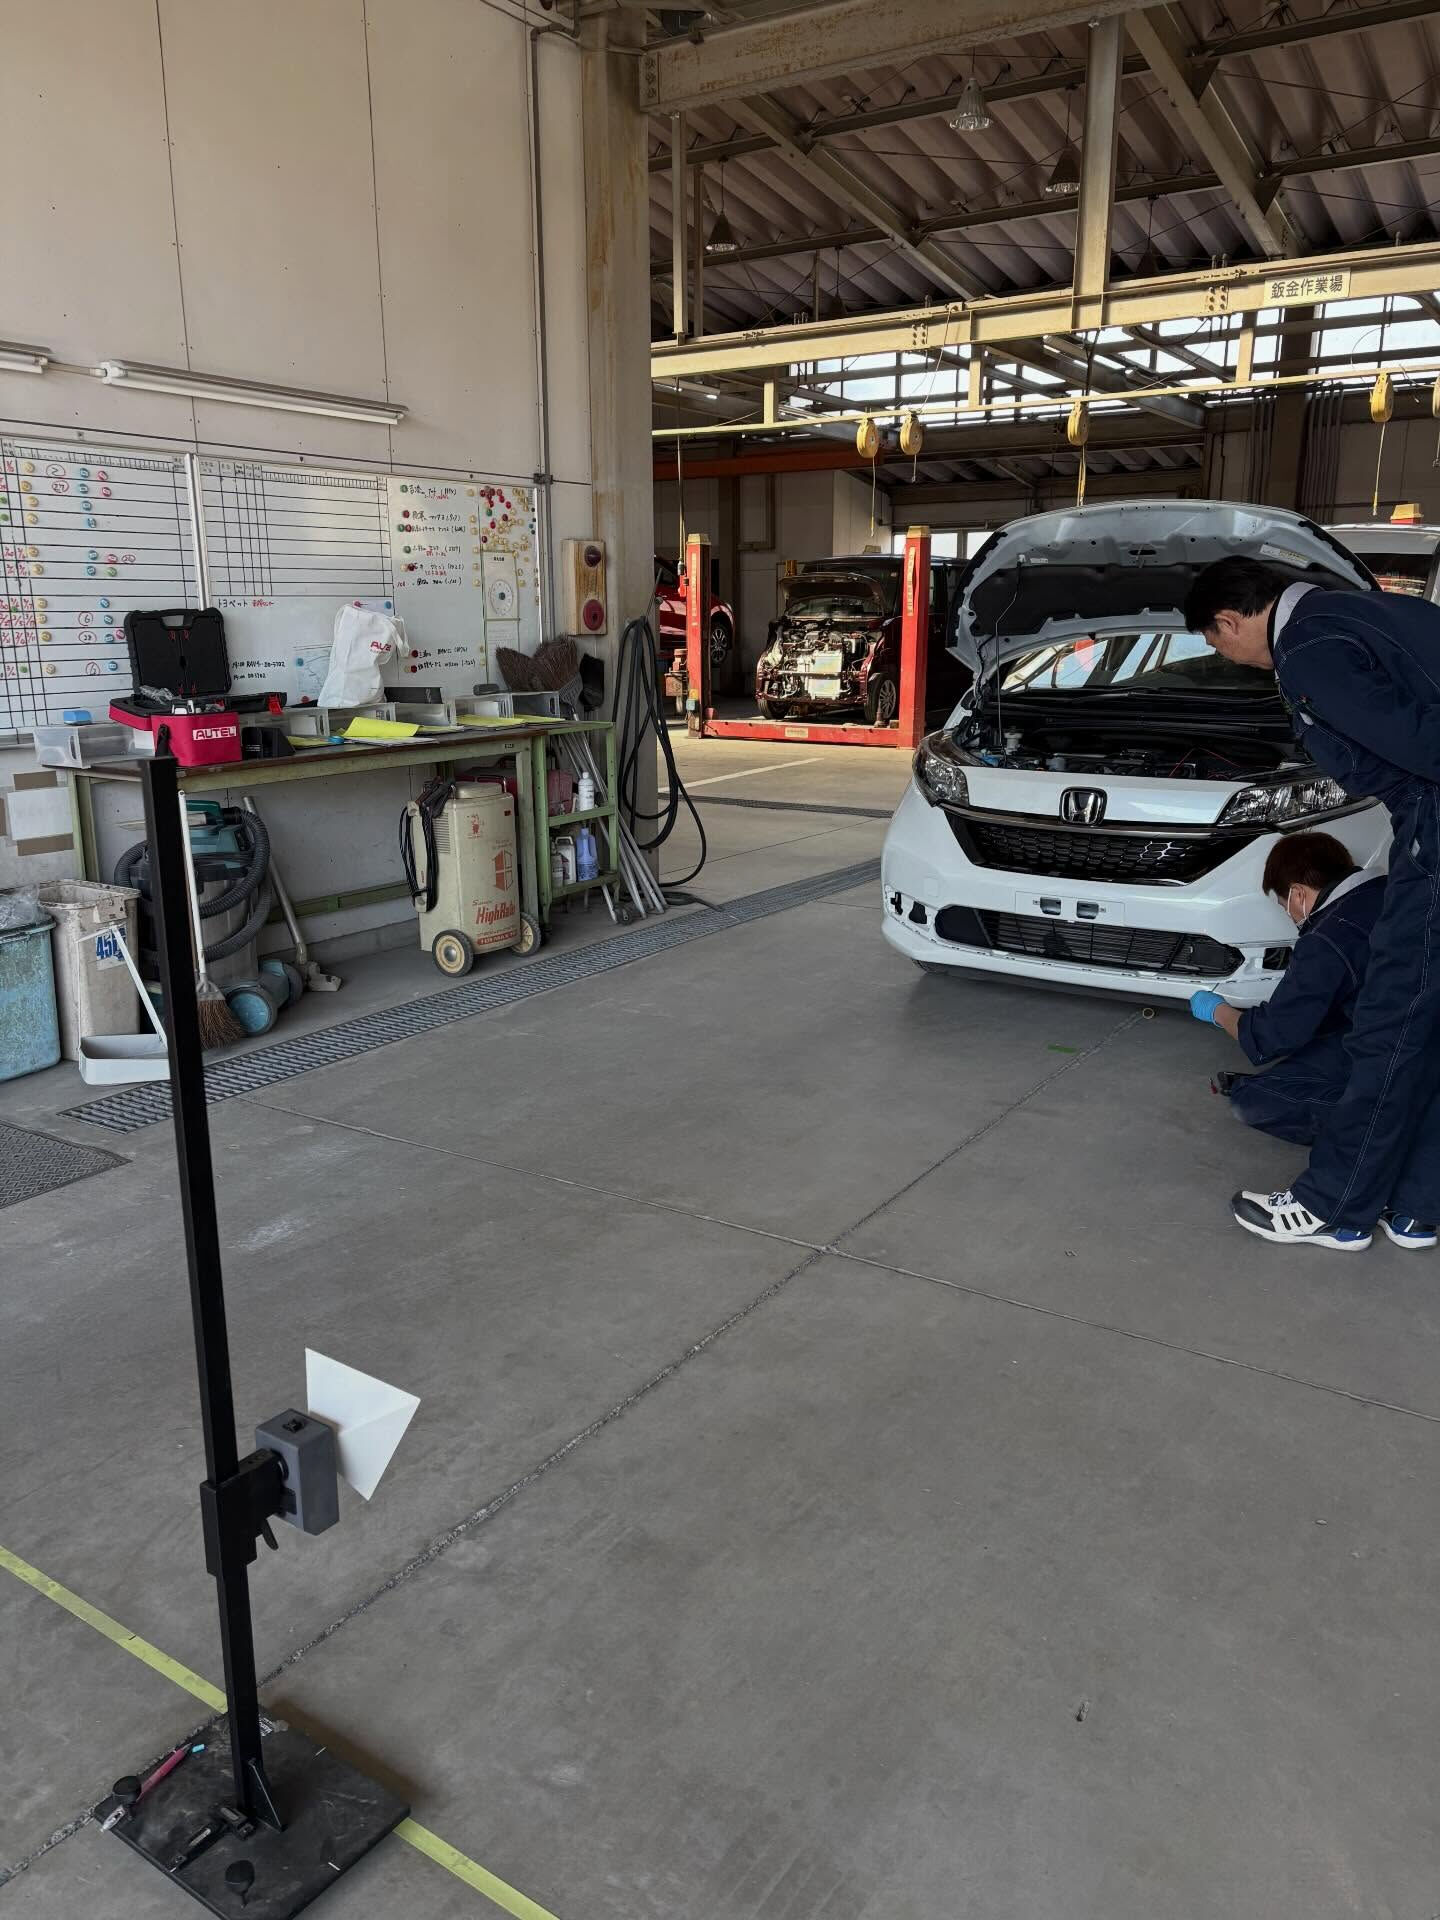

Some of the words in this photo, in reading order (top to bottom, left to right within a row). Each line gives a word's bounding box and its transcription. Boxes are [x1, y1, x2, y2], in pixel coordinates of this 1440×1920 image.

[1271, 274, 1343, 299] 鈑金作業場
[195, 727, 235, 740] AUTEL
